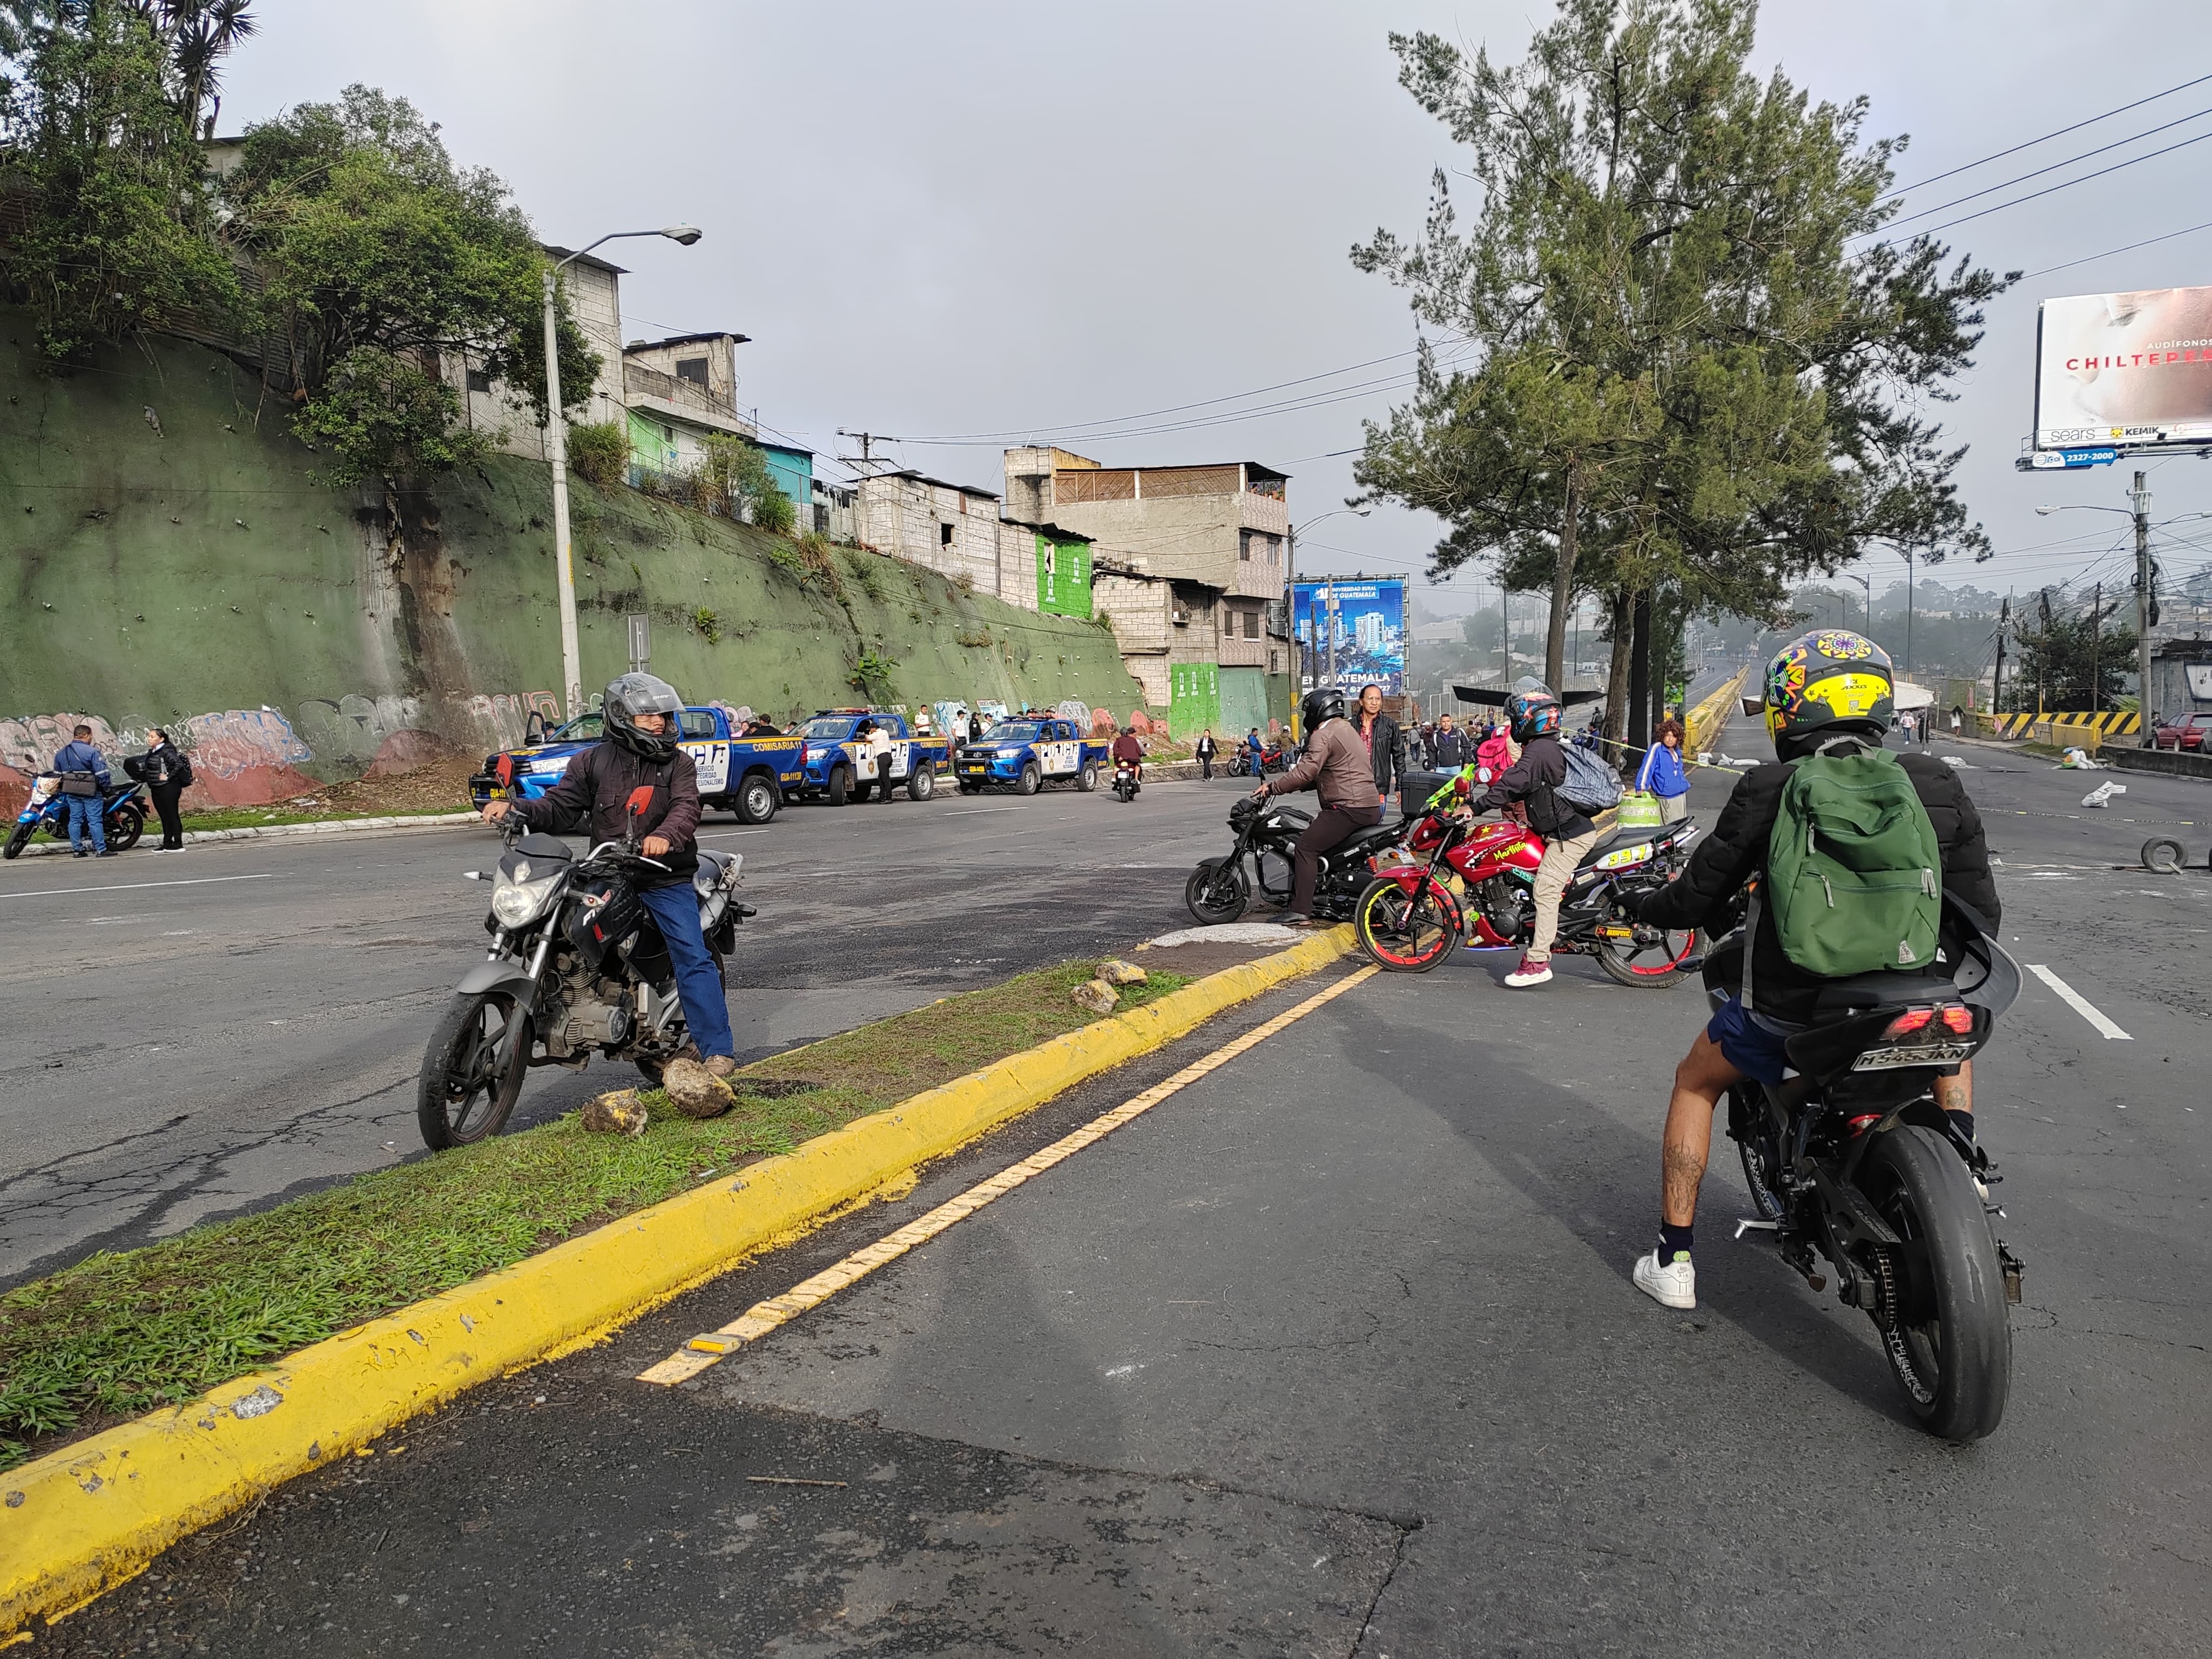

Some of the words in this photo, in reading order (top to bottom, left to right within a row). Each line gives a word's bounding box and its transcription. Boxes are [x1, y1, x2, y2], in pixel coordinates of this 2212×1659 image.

[2051, 429, 2095, 442] sears
[2126, 427, 2159, 436] KEMIK
[2067, 452, 2114, 462] 2327-2000
[1493, 841, 1527, 861] Marthita
[1608, 845, 1647, 867] 397
